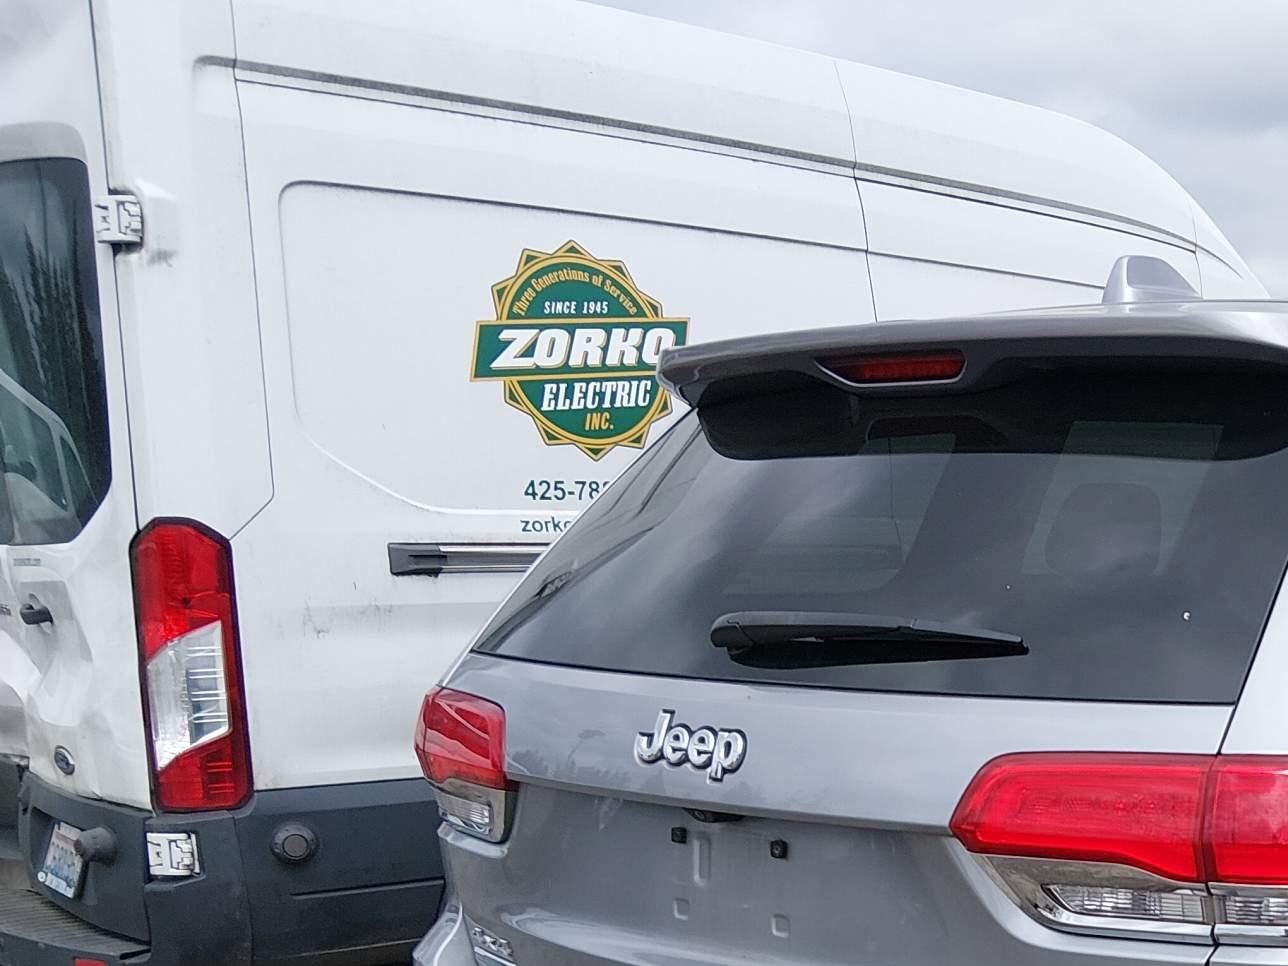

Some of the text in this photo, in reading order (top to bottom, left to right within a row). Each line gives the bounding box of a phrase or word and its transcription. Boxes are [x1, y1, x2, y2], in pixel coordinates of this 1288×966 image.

[512, 267, 637, 316] Three Generations of Service
[543, 300, 609, 315] SINCE 1945
[489, 327, 676, 370] ZORKO
[541, 380, 652, 411] ELECTRIC
[584, 411, 615, 431] INC.
[524, 479, 610, 501] 425-78
[637, 709, 747, 782] Jeep
